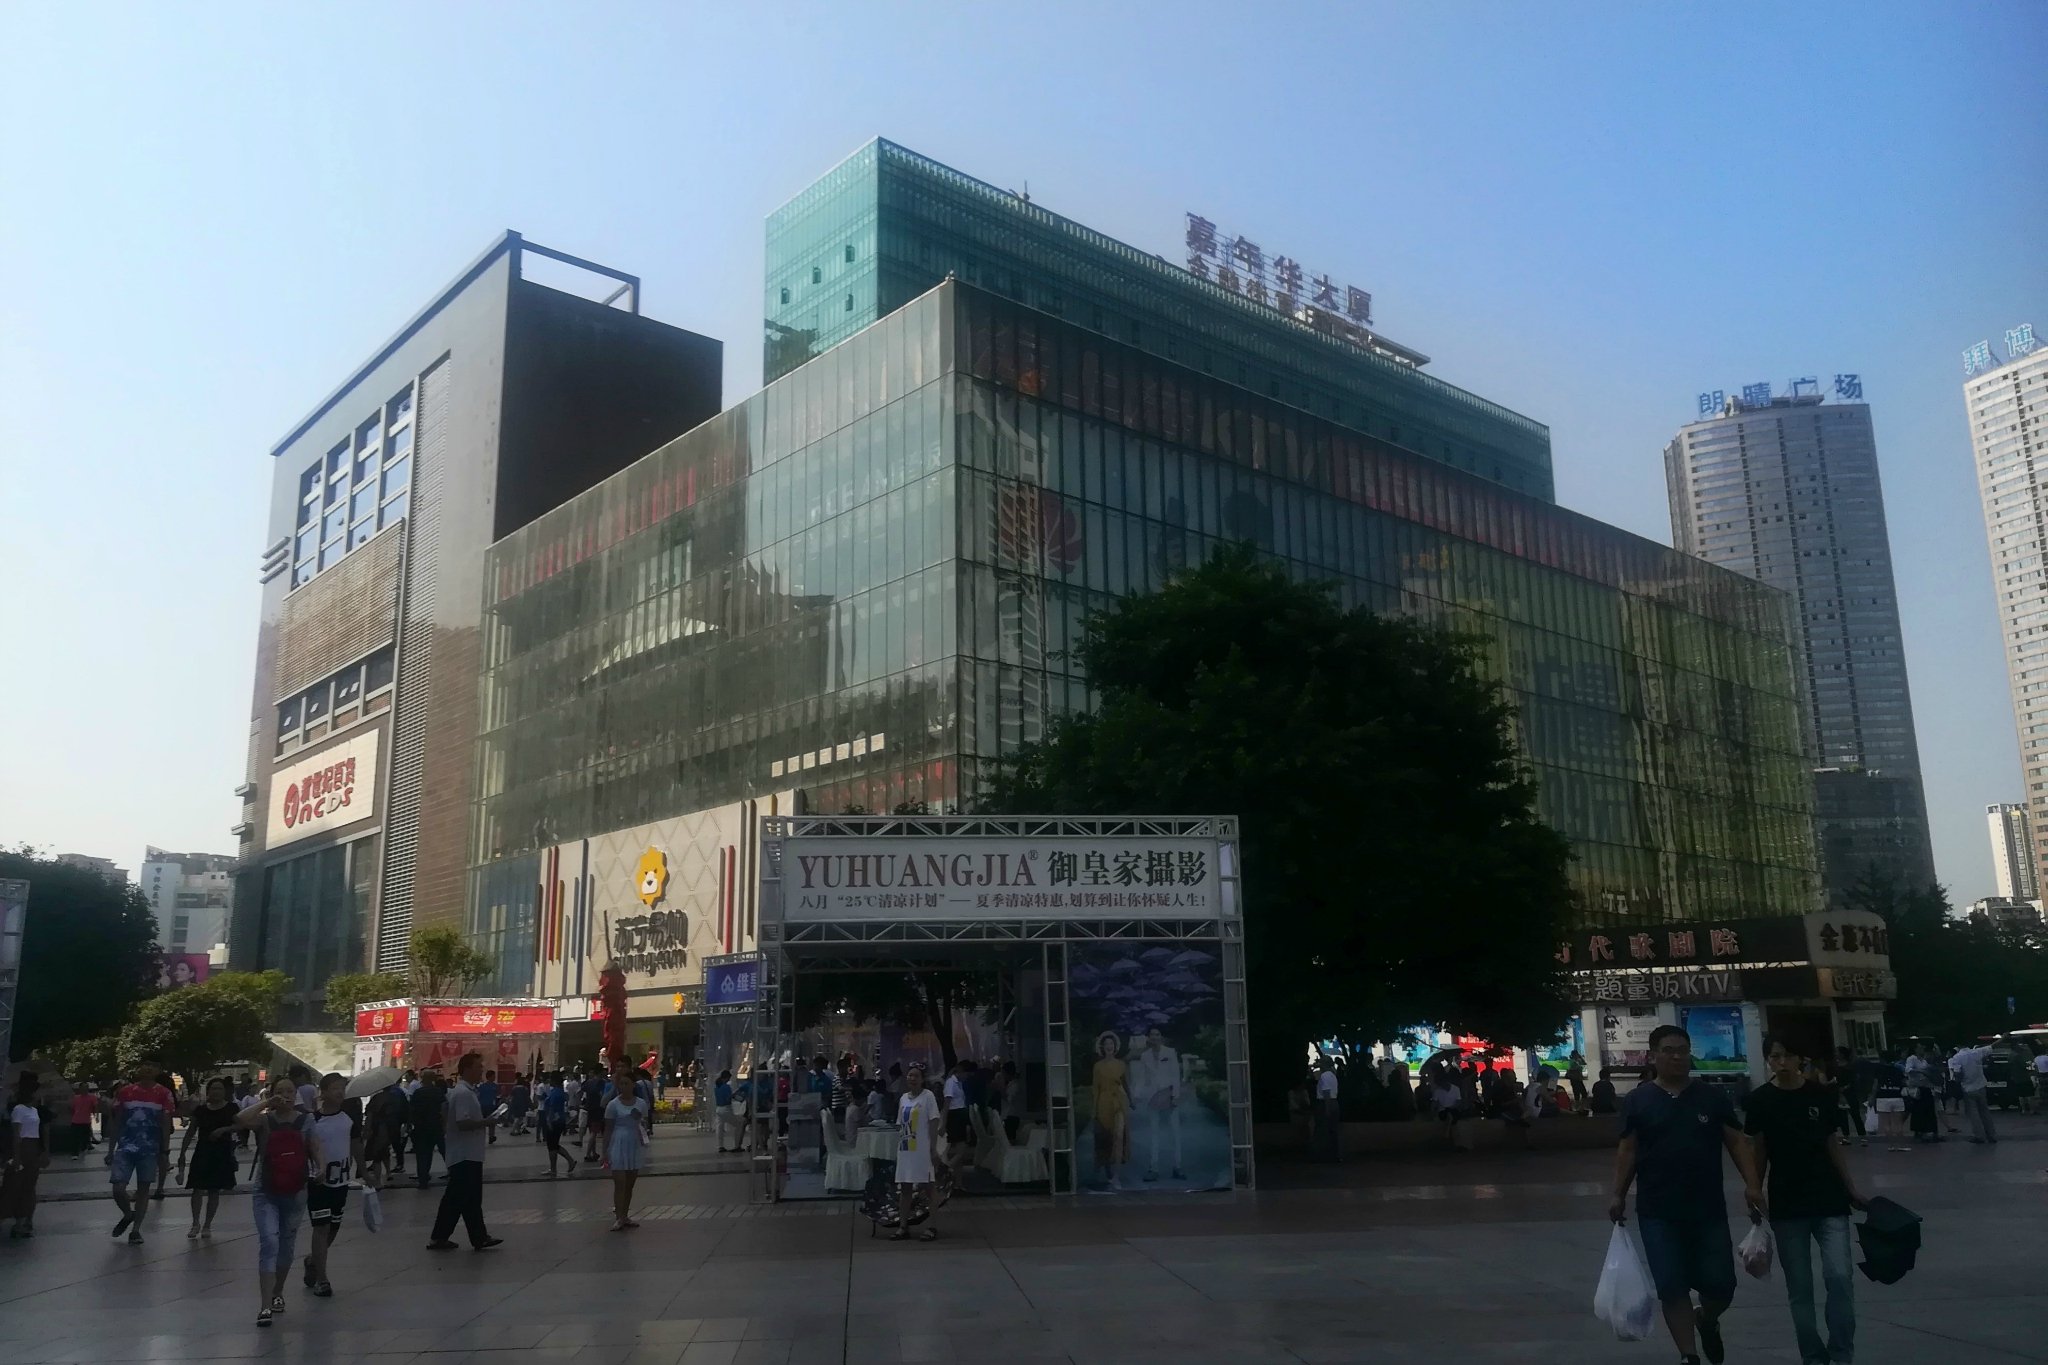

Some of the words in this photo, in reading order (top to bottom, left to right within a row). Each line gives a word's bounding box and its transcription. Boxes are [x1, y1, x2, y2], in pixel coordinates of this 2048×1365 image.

[1699, 373, 1864, 415] 朗晴广场
[1048, 849, 1208, 888] 御皇家攝影
